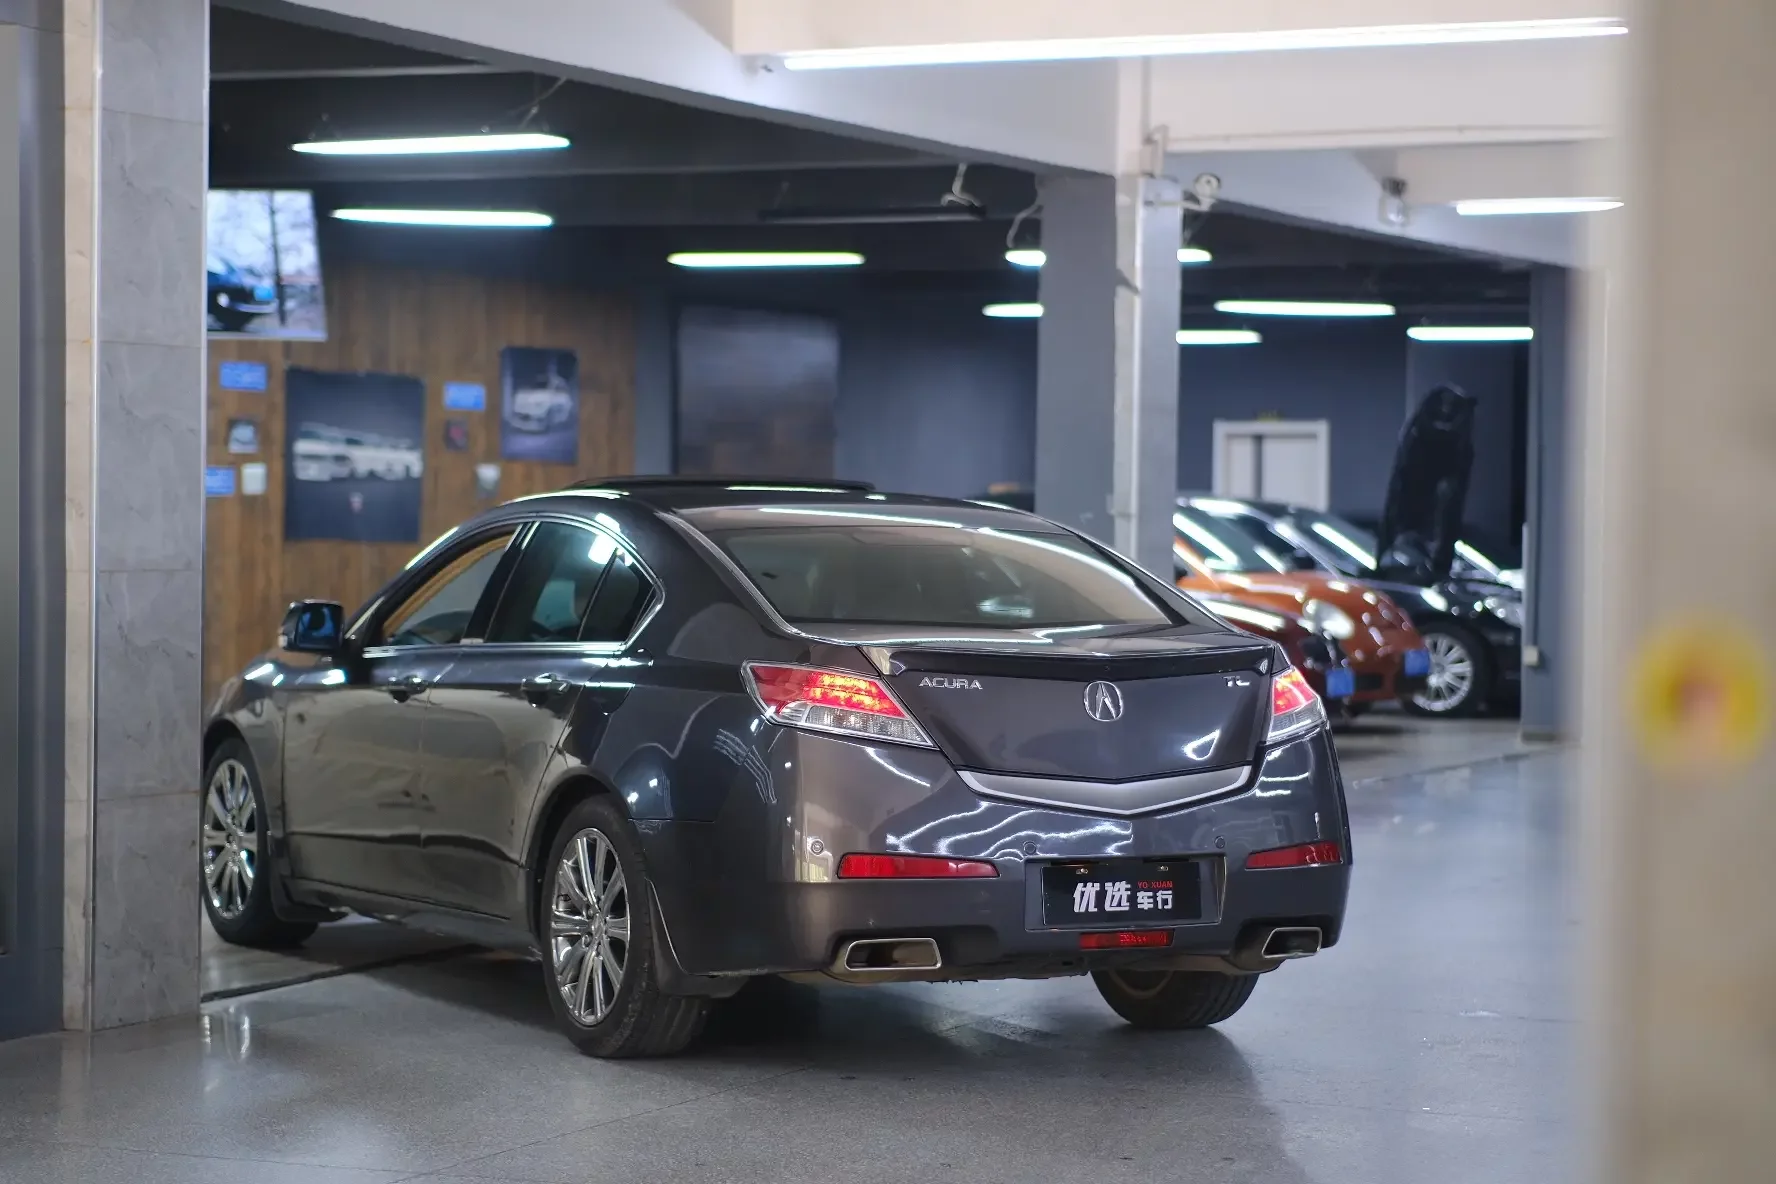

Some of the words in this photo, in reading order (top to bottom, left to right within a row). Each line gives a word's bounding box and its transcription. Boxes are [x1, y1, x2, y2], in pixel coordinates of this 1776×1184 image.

[919, 676, 983, 690] ACURA
[1222, 675, 1250, 687] TL
[1151, 880, 1173, 889] XUAN
[1073, 880, 1132, 913] 优选
[1136, 890, 1173, 910] 车行
